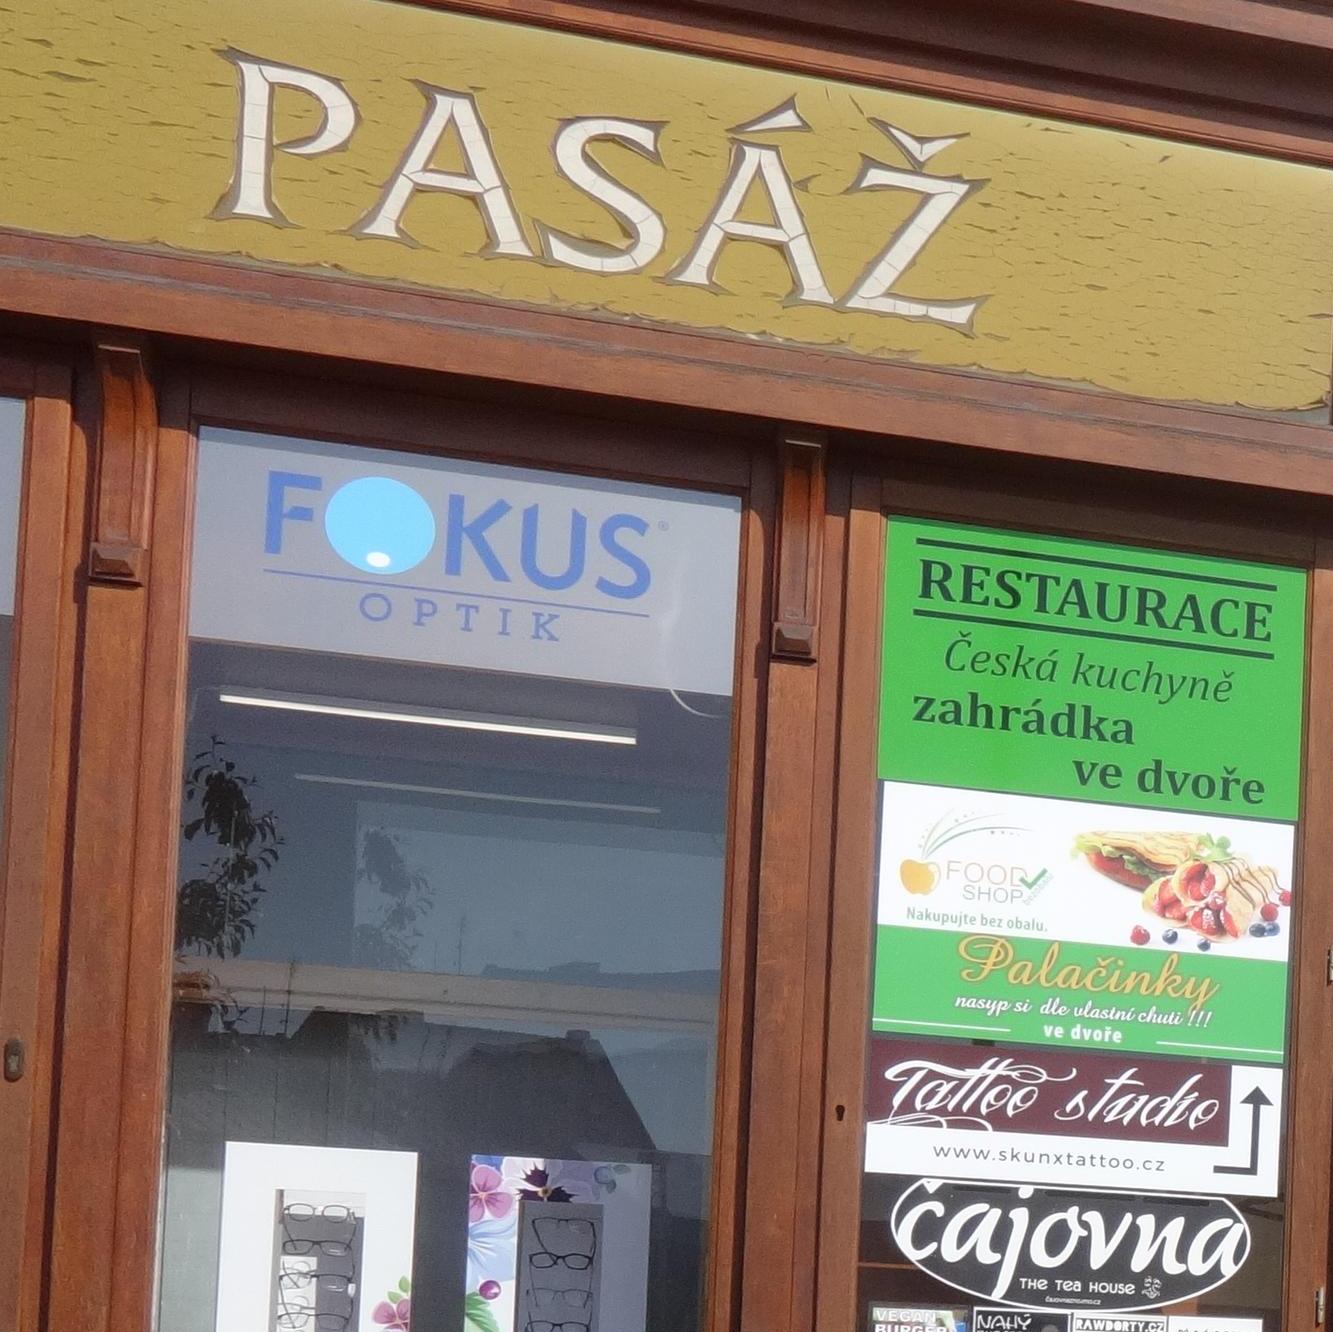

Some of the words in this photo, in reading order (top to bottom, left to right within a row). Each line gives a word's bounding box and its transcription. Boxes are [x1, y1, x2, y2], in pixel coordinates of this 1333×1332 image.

[212, 47, 991, 336] PASÁŽ
[917, 559, 1273, 642] RESTAURACE
[359, 592, 561, 642] OPTIK
[945, 630, 1059, 683] Česká
[1071, 651, 1235, 705] kuchyně
[912, 691, 1135, 745] zahrádka
[1072, 760, 1123, 790] ve
[1137, 758, 1265, 804] dvoře
[946, 860, 1029, 887] FOOD
[962, 884, 1024, 904] SHOP
[907, 906, 976, 928] Nakupujte
[980, 914, 1004, 928] bez
[1007, 916, 1048, 932] obalu.
[957, 934, 1220, 1017] Palačinky
[955, 996, 1010, 1017] nasyp
[1013, 998, 1032, 1013] si
[1040, 997, 1070, 1016] dle
[1073, 1001, 1136, 1022] vlastní
[1138, 1006, 1184, 1026] chuti
[1043, 1024, 1064, 1039] ve
[1071, 1022, 1122, 1043] dvoře
[881, 1057, 1075, 1128] Tattoo
[1054, 1067, 1219, 1131] studio
[933, 1145, 1165, 1171] www.skunxtattoo.cz
[875, 1309, 936, 1323] VEGAN
[976, 1314, 1032, 1330] NAHÝ
[1075, 1318, 1164, 1332] RAWDORTY.CZ
